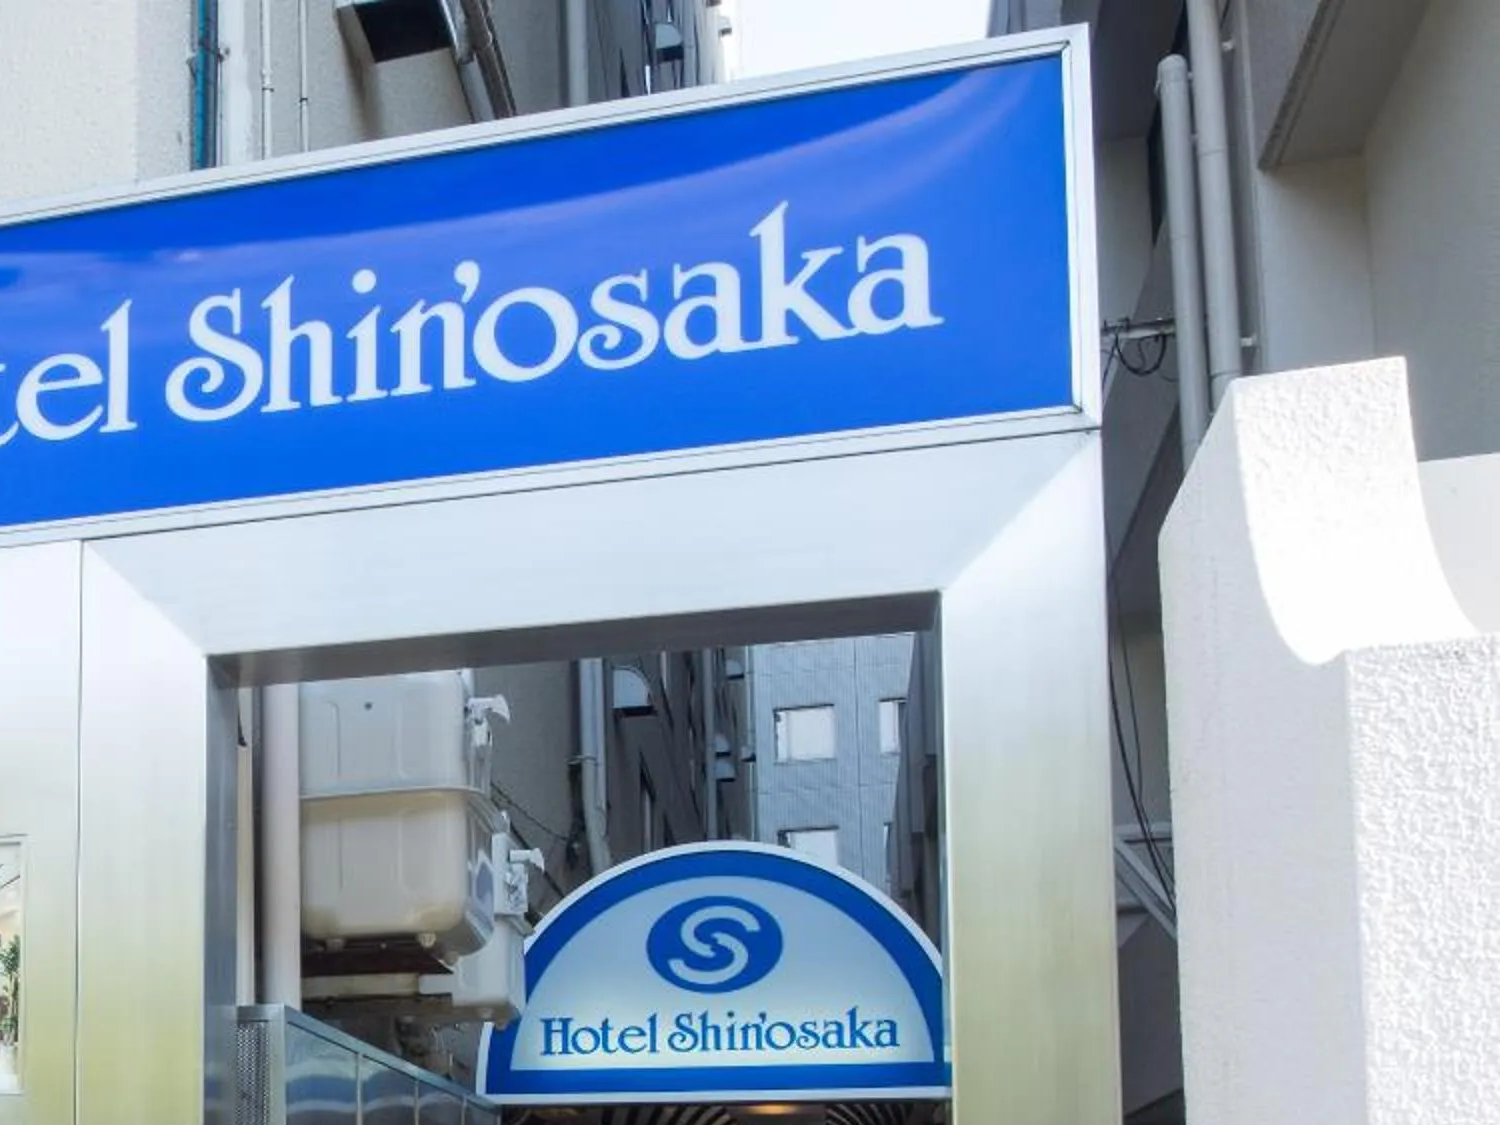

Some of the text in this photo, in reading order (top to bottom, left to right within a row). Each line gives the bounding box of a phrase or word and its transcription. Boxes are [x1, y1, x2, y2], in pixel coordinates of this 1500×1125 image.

[165, 200, 944, 422] Shin'osaka
[540, 1006, 900, 1057] Hotel Shin'osaka
